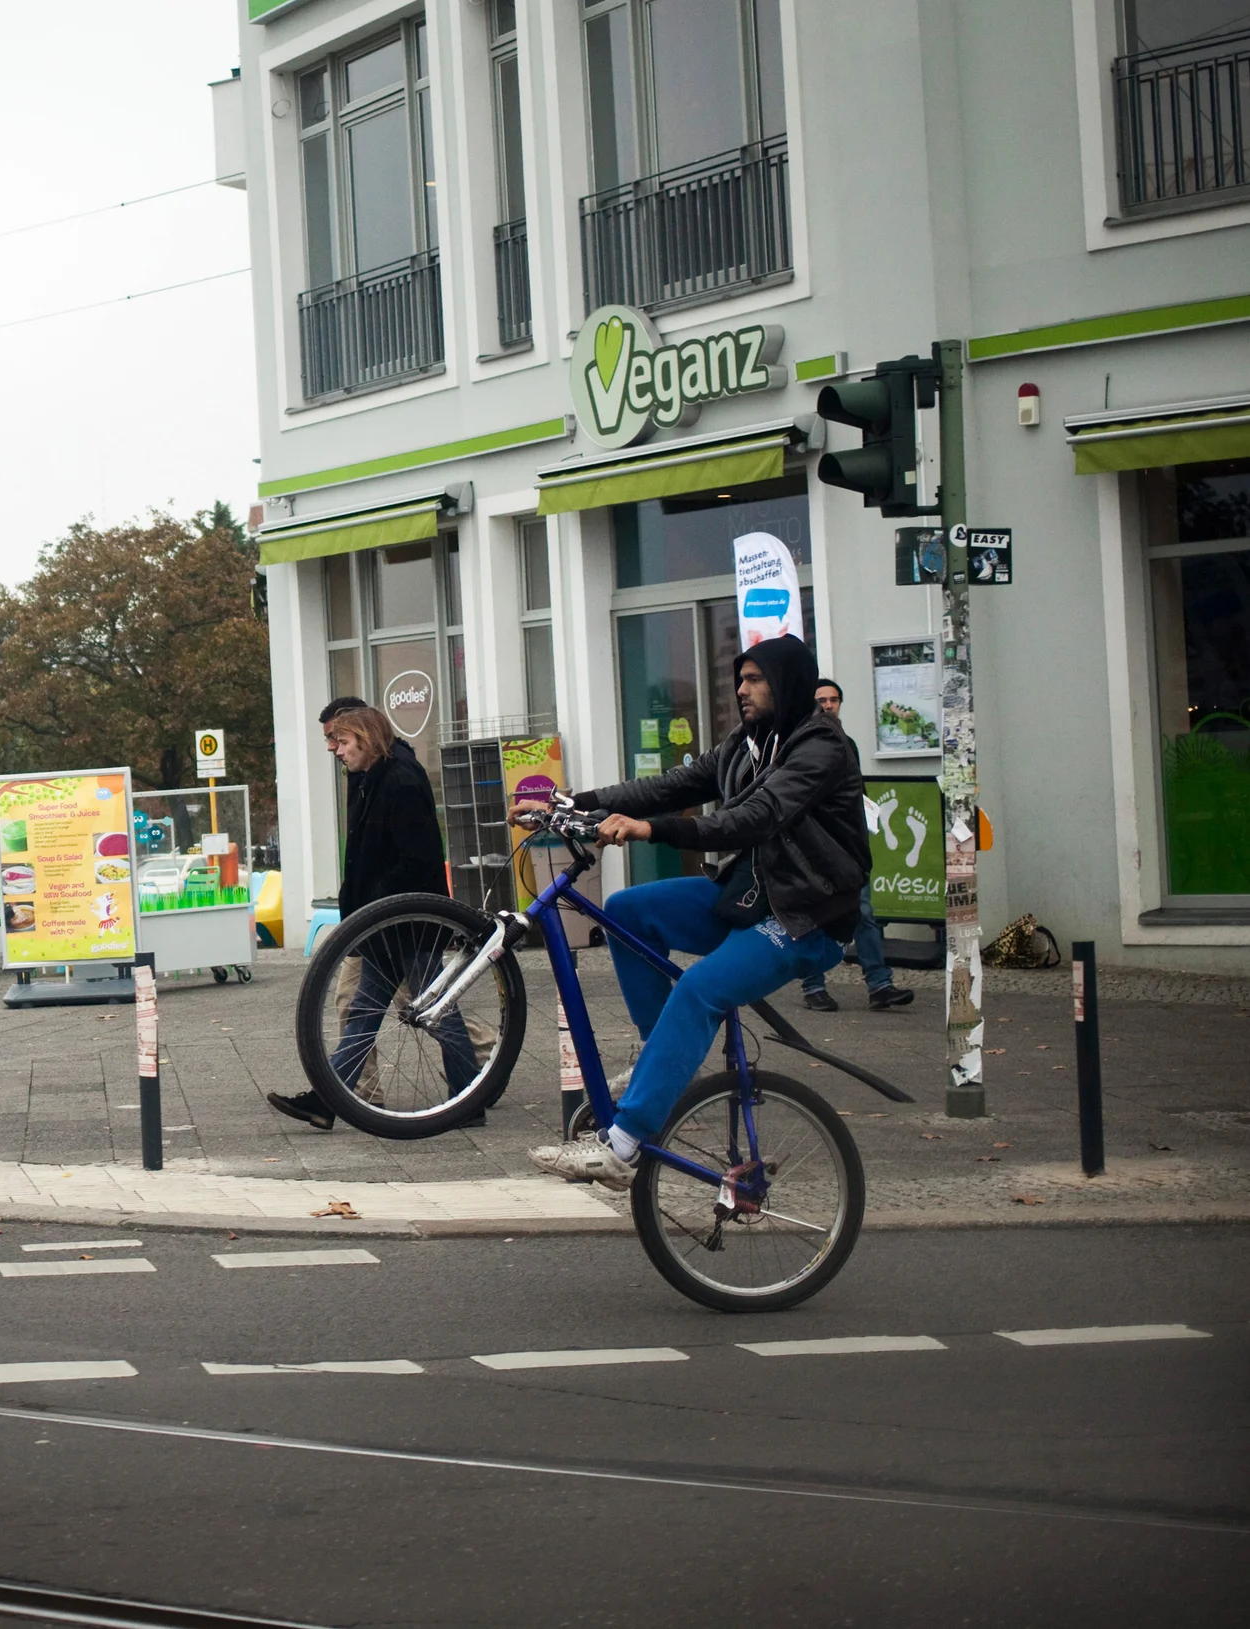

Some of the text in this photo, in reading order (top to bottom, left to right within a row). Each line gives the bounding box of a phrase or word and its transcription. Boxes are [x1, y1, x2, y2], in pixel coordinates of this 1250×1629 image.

[586, 322, 769, 433] Veganz
[973, 534, 1005, 545] EASY
[739, 551, 769, 565] Massen-
[739, 558, 782, 576] tierhaltung
[739, 567, 783, 587] abschaffen!
[203, 739, 213, 752] H
[38, 802, 78, 812] Super Food
[29, 812, 66, 821] Smoothies
[77, 810, 100, 818] Juices
[37, 855, 55, 863] Soup
[63, 853, 83, 861] Salad
[48, 883, 70, 892] Vegan
[873, 872, 939, 894] avesu
[60, 890, 92, 898] Soulfood
[41, 920, 66, 928] Coffee
